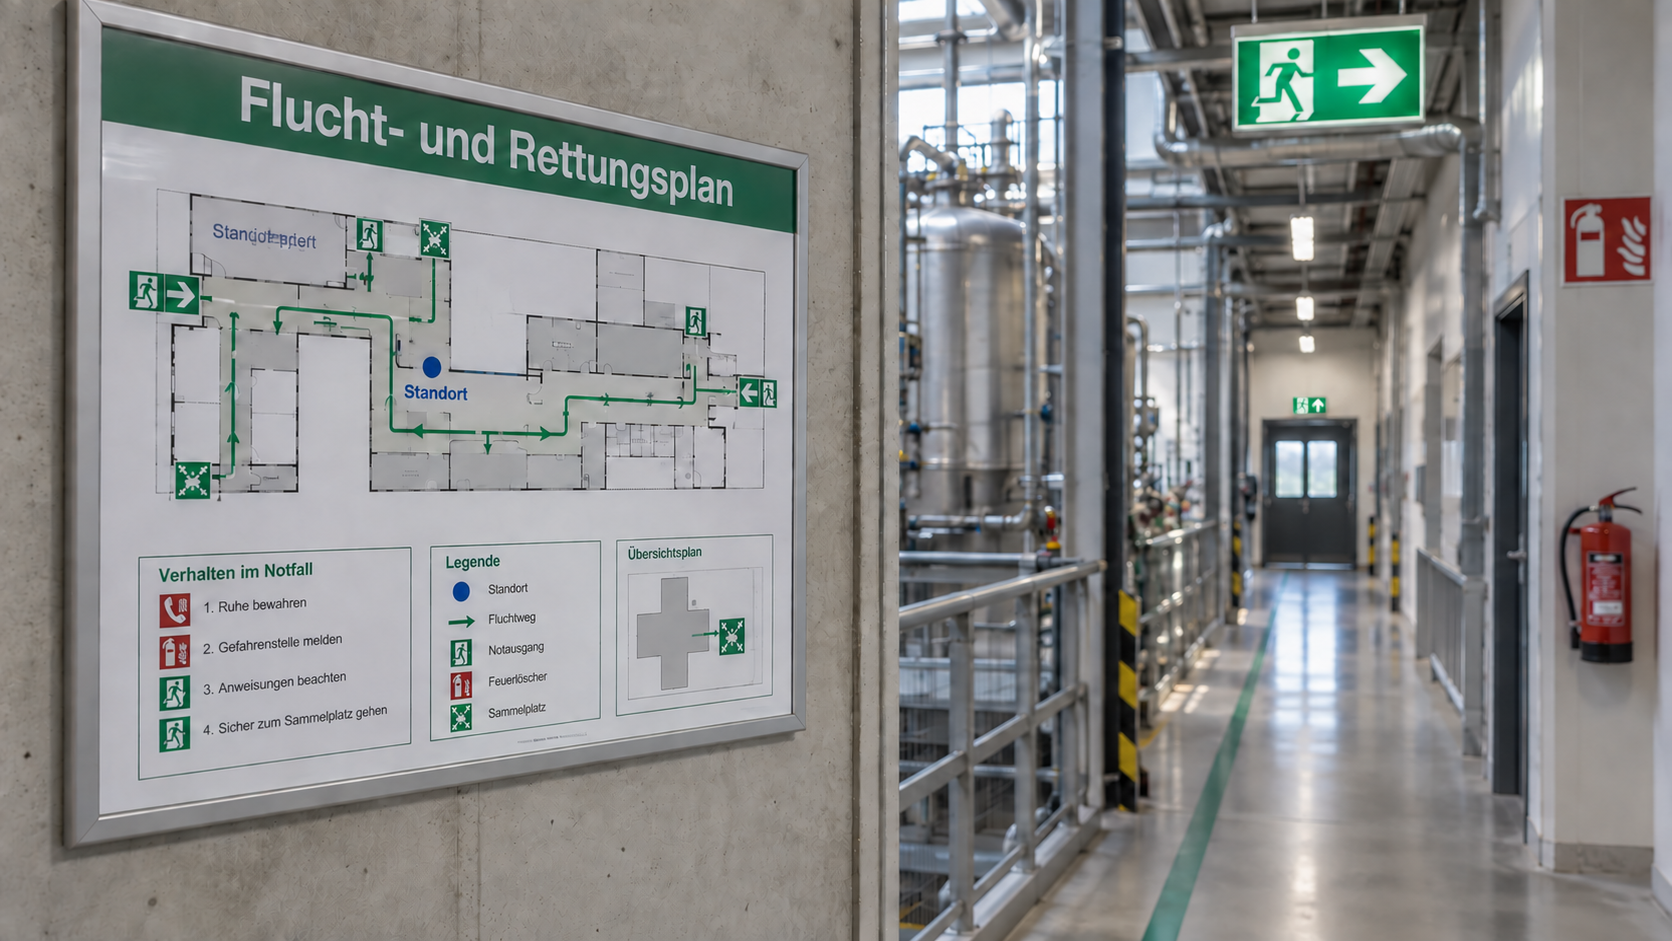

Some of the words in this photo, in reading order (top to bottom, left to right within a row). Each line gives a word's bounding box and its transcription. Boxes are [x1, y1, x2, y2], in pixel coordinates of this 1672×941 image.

[241, 75, 404, 147] Flucht-
[420, 122, 495, 165] und
[510, 129, 734, 207] Rettungsplan
[404, 383, 468, 401] Standort
[628, 545, 703, 561] Übersichtsplan
[158, 565, 236, 583] Verhalten
[240, 564, 260, 579] im
[264, 561, 313, 578] Notfall
[446, 554, 501, 572] Legende
[488, 583, 529, 596] Standort
[203, 601, 214, 614] 1.
[218, 600, 250, 613] Ruhe
[252, 597, 307, 611] bewahren
[488, 612, 536, 626] Fluchtweg
[203, 643, 214, 655] 2.
[218, 636, 300, 654] Gefahrenstelle
[302, 633, 343, 647] melden
[488, 642, 545, 656] Notausgang
[203, 683, 214, 696] 3.
[218, 677, 295, 695] Anweisungen
[297, 671, 347, 686] beachten
[488, 671, 548, 688] Feuerlöscher
[488, 702, 547, 720] Sammelplatz
[203, 724, 214, 736] 4.
[218, 719, 256, 735] Sicher
[257, 718, 282, 731] zum
[284, 707, 354, 728] Sammelplatz
[355, 705, 388, 722] gehen
